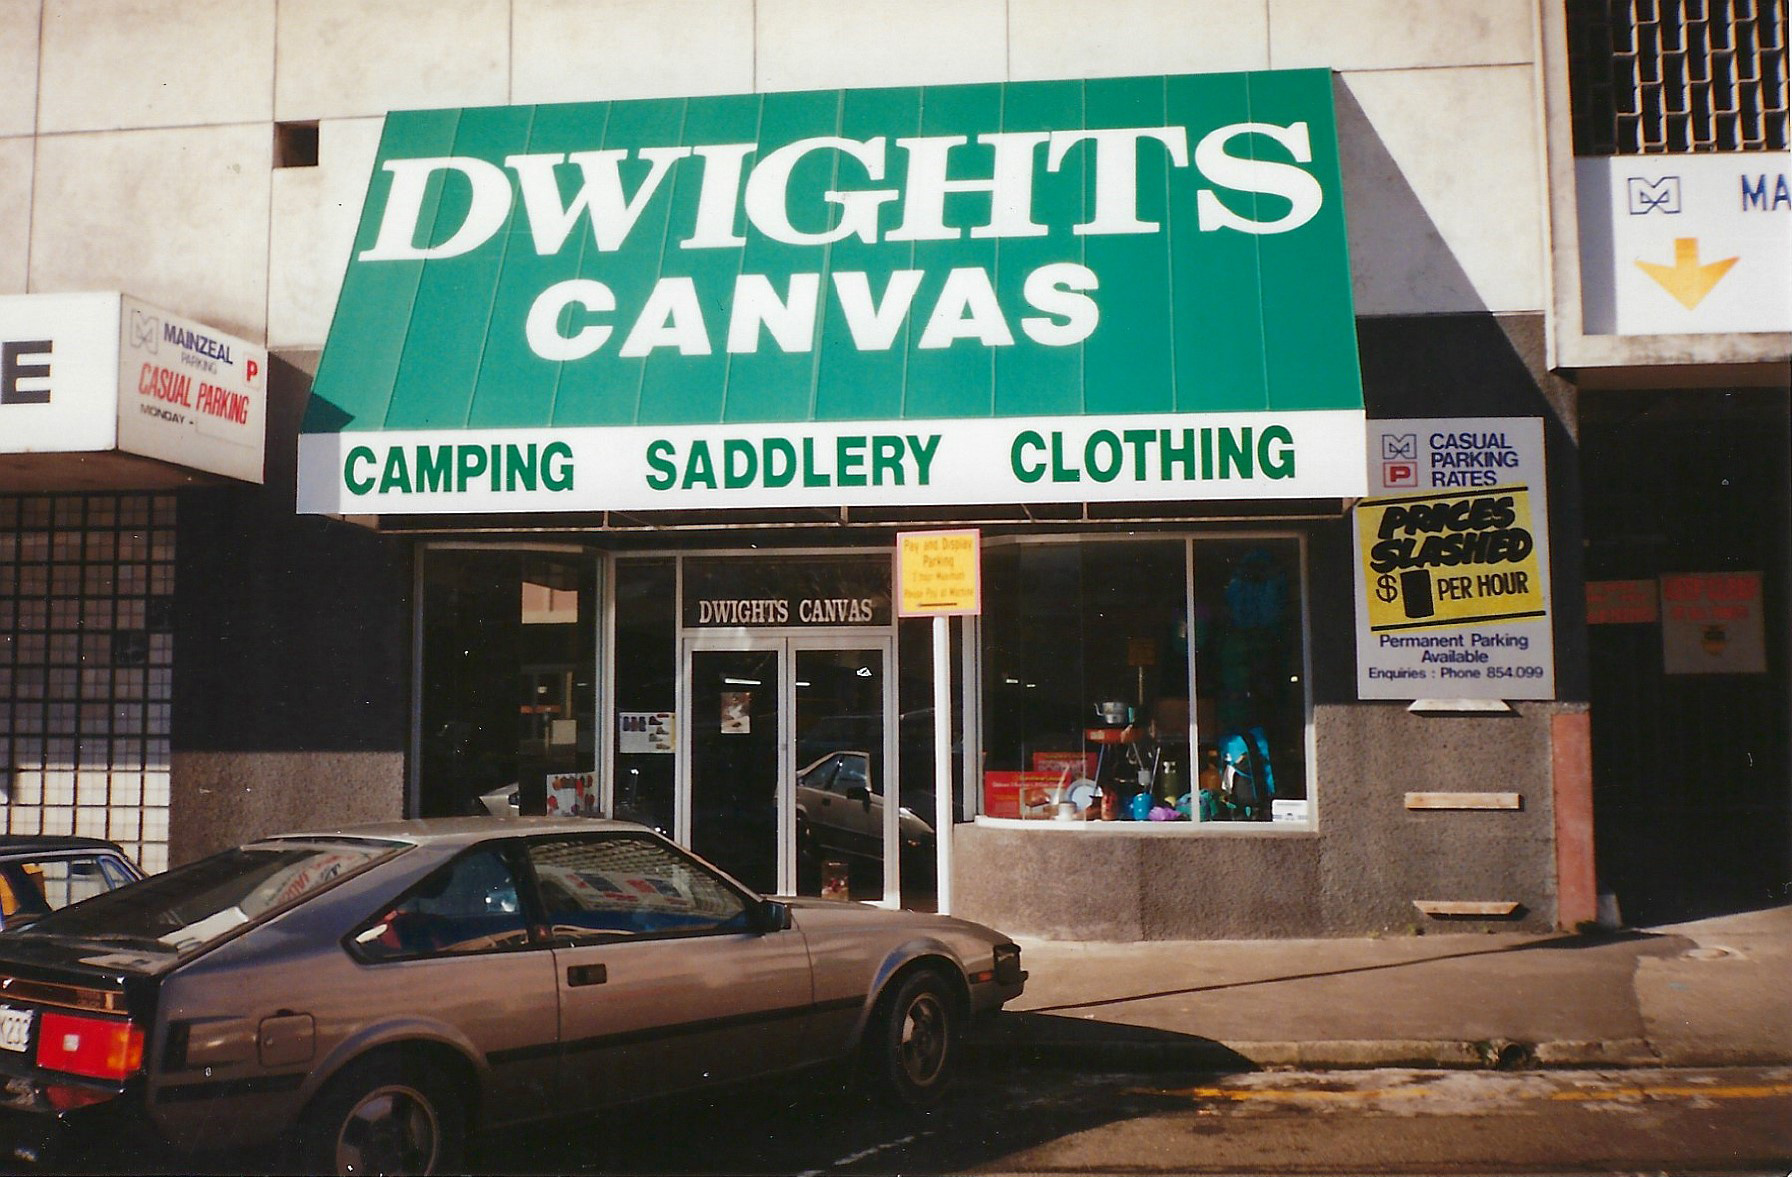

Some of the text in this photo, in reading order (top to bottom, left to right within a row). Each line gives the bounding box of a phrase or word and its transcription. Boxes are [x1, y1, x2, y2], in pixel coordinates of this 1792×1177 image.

[357, 120, 1325, 263] DWIGHTS
[525, 262, 1099, 362] CANVAS
[164, 322, 233, 365] MAINZEAL
[246, 359, 258, 382] P
[138, 363, 250, 425] CASUAL PARKING
[140, 403, 186, 425] MONDAY
[1429, 432, 1513, 450] CASUAL
[343, 424, 1297, 496] CAMPING SADDLERY CLOTHING
[1431, 451, 1519, 468] PARKING
[1389, 466, 1411, 483] P
[1432, 470, 1498, 488] RATES
[1377, 496, 1516, 540] PRICES
[1369, 527, 1534, 571] SLASHED
[1437, 576, 1473, 601] PER
[1476, 571, 1529, 598] HOUR
[699, 598, 873, 624] DWIGHTS CANVAS
[1380, 633, 1529, 650] Permanent Parking
[1421, 650, 1489, 664] Available
[1368, 667, 1427, 681] Enquiries
[1440, 667, 1481, 680] Phone
[1486, 666, 1544, 680] 854.099
